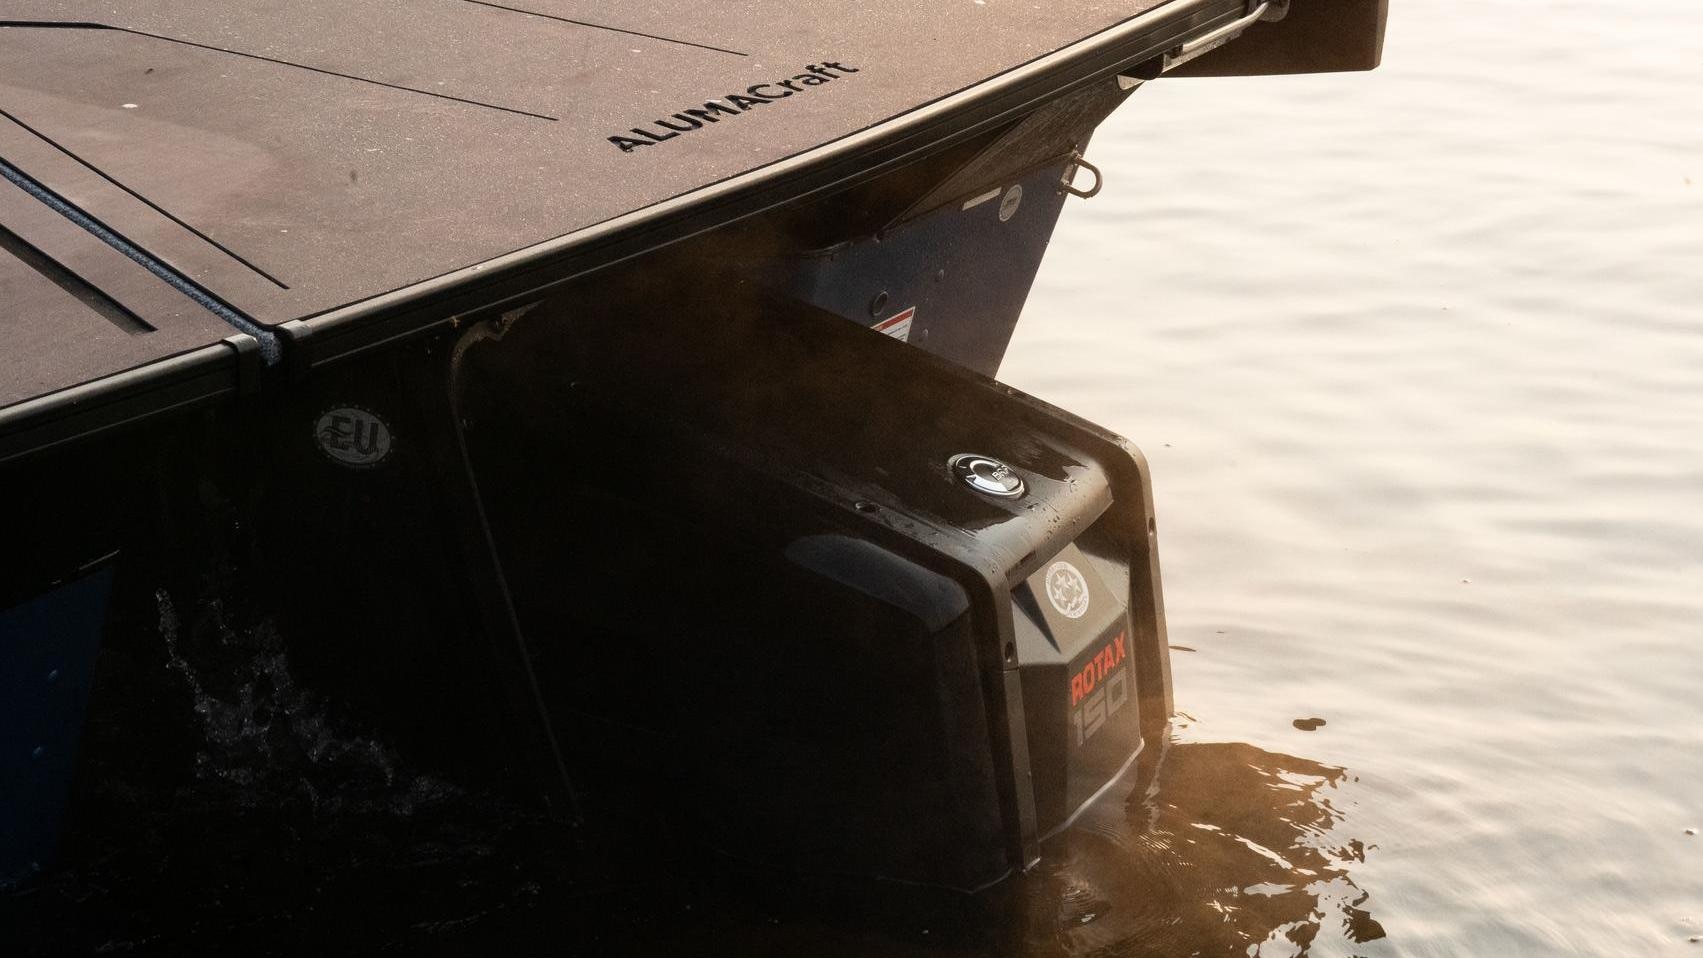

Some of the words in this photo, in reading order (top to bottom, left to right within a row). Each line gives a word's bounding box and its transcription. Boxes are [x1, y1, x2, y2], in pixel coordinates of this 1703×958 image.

[607, 61, 859, 152] ALUMACraft
[1071, 633, 1127, 707] ROTAX
[1073, 667, 1127, 746] 150
